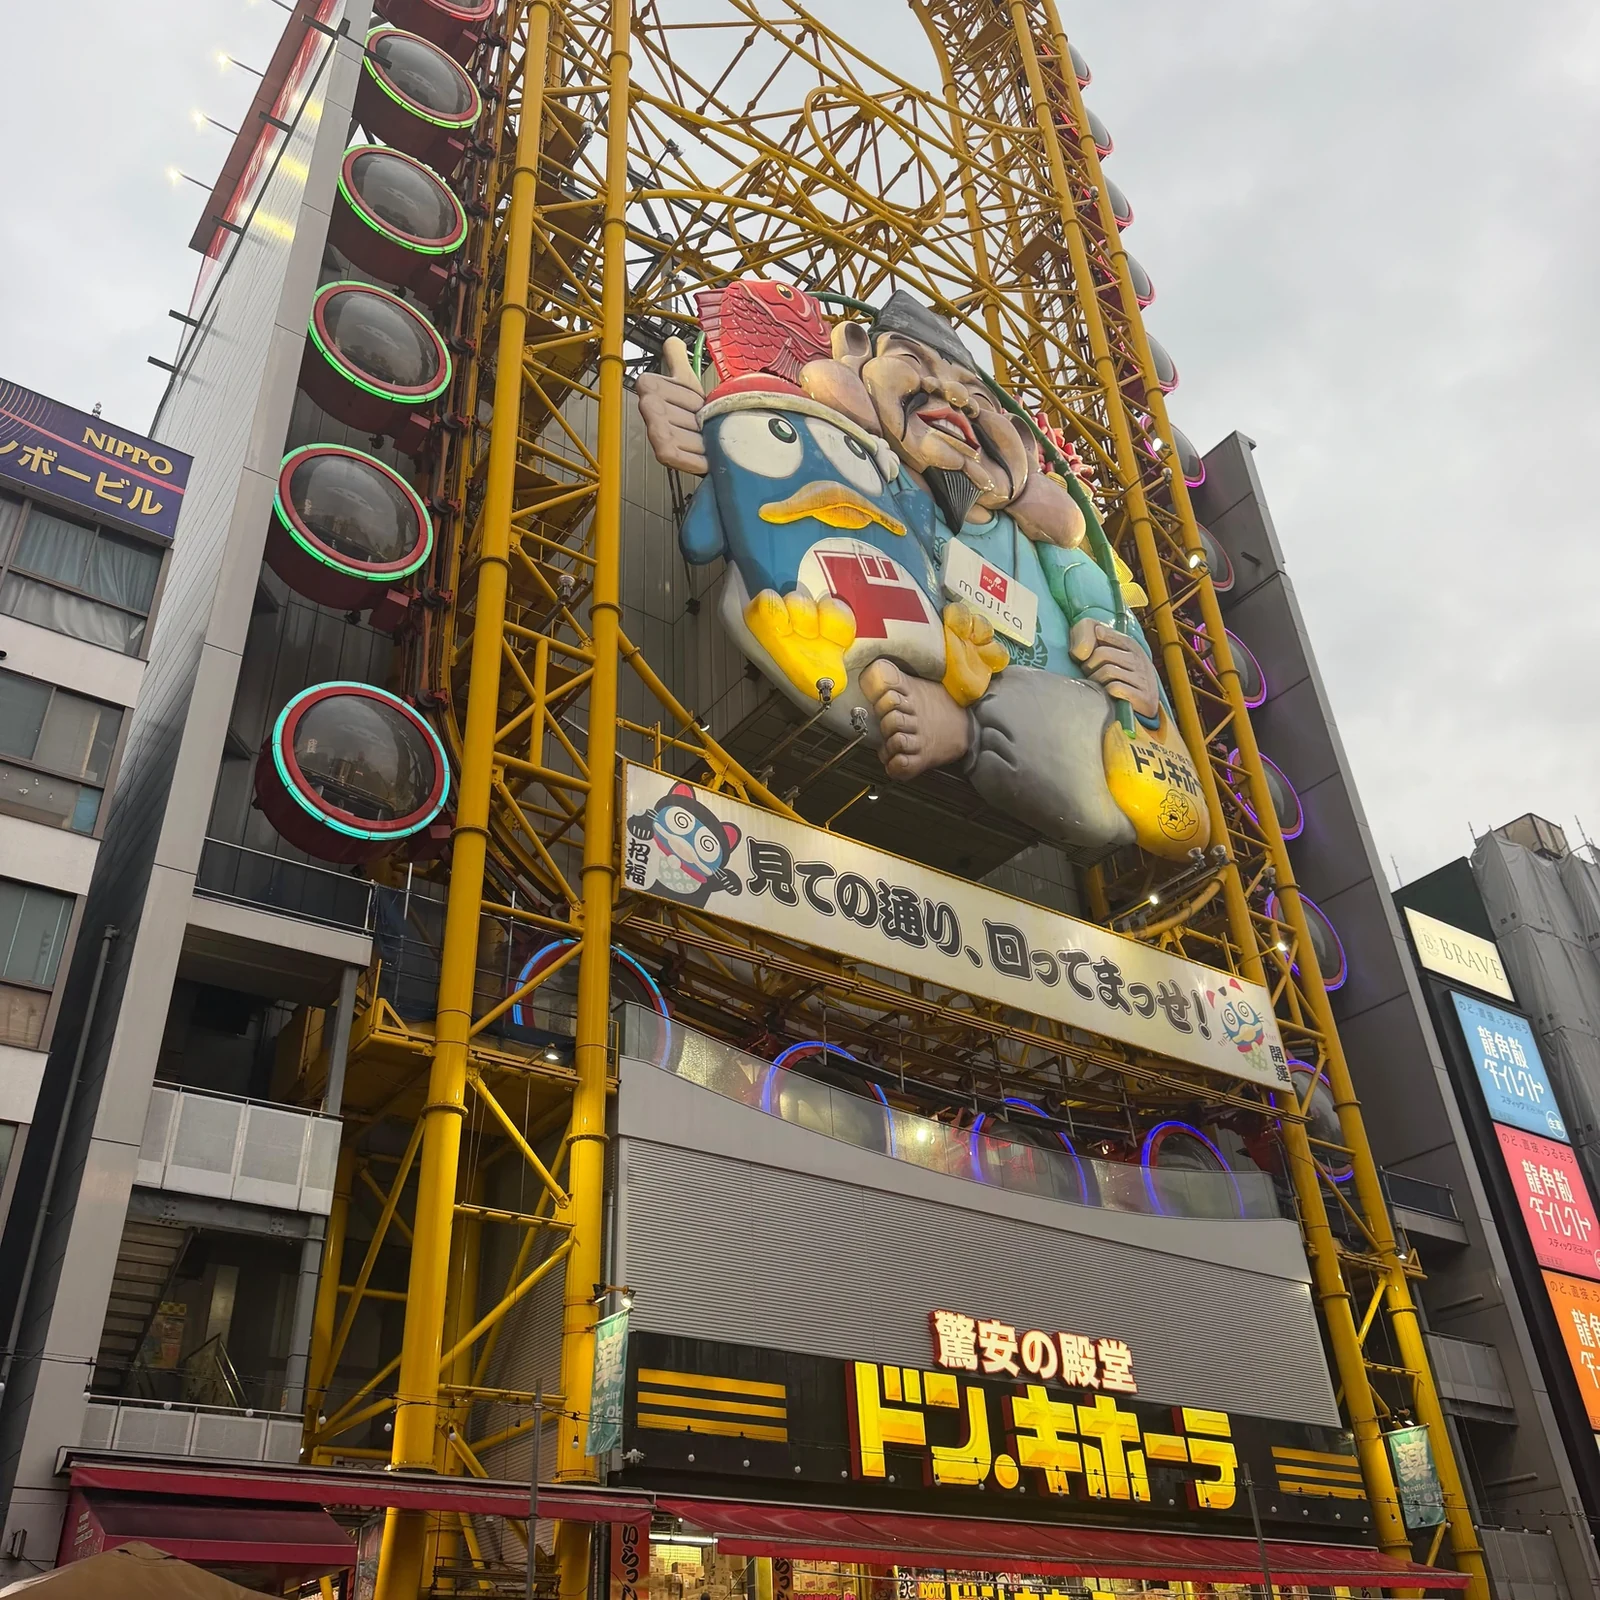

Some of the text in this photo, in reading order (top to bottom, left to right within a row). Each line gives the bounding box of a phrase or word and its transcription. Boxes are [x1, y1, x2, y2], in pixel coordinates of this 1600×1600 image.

[82, 426, 173, 475] NIPPO
[958, 579, 1024, 630] majica
[1439, 937, 1504, 981] BRAVE
[1476, 1025, 1530, 1069] 龍角散
[1520, 1158, 1576, 1205] 龍角散
[934, 1308, 1138, 1394] 驚安の殿堂
